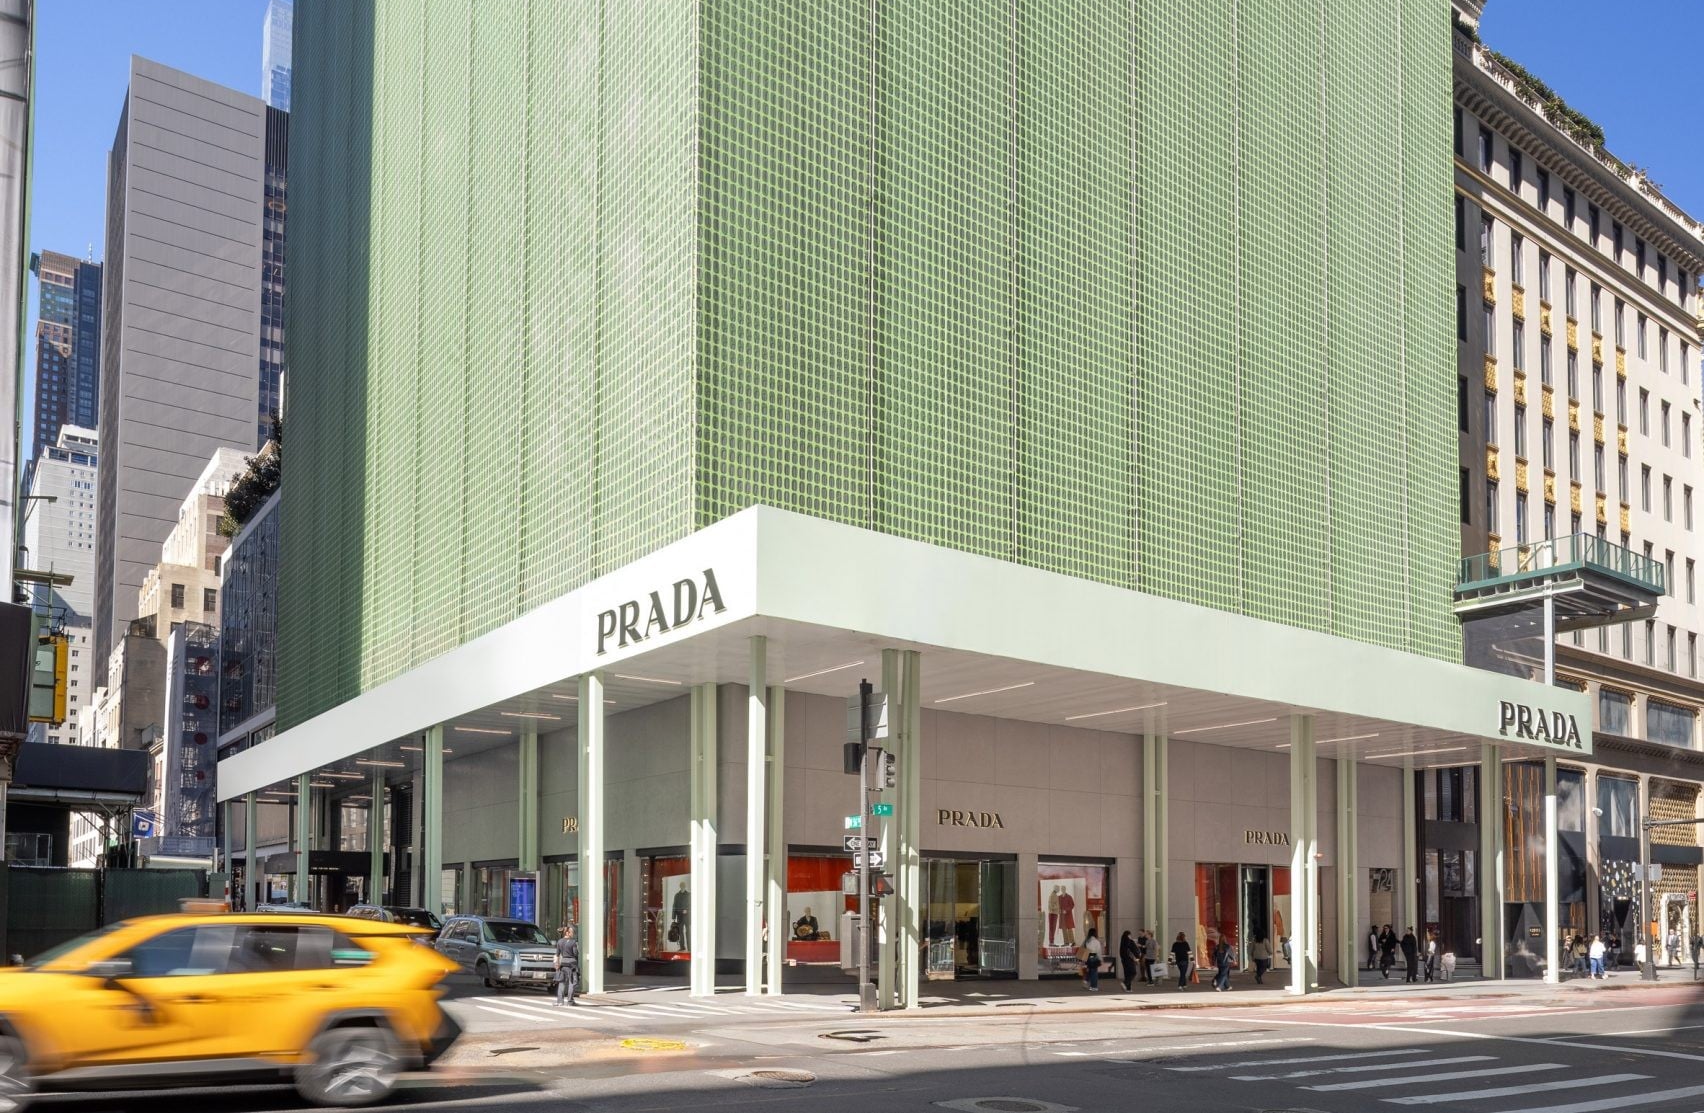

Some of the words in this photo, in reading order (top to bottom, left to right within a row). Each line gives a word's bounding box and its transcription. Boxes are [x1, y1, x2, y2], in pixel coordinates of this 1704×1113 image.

[596, 568, 727, 656] PRADA
[1499, 700, 1582, 749] PRADA
[937, 809, 1004, 829] PRADA
[1244, 830, 1290, 846] PRADA
[1373, 869, 1393, 891] 724
